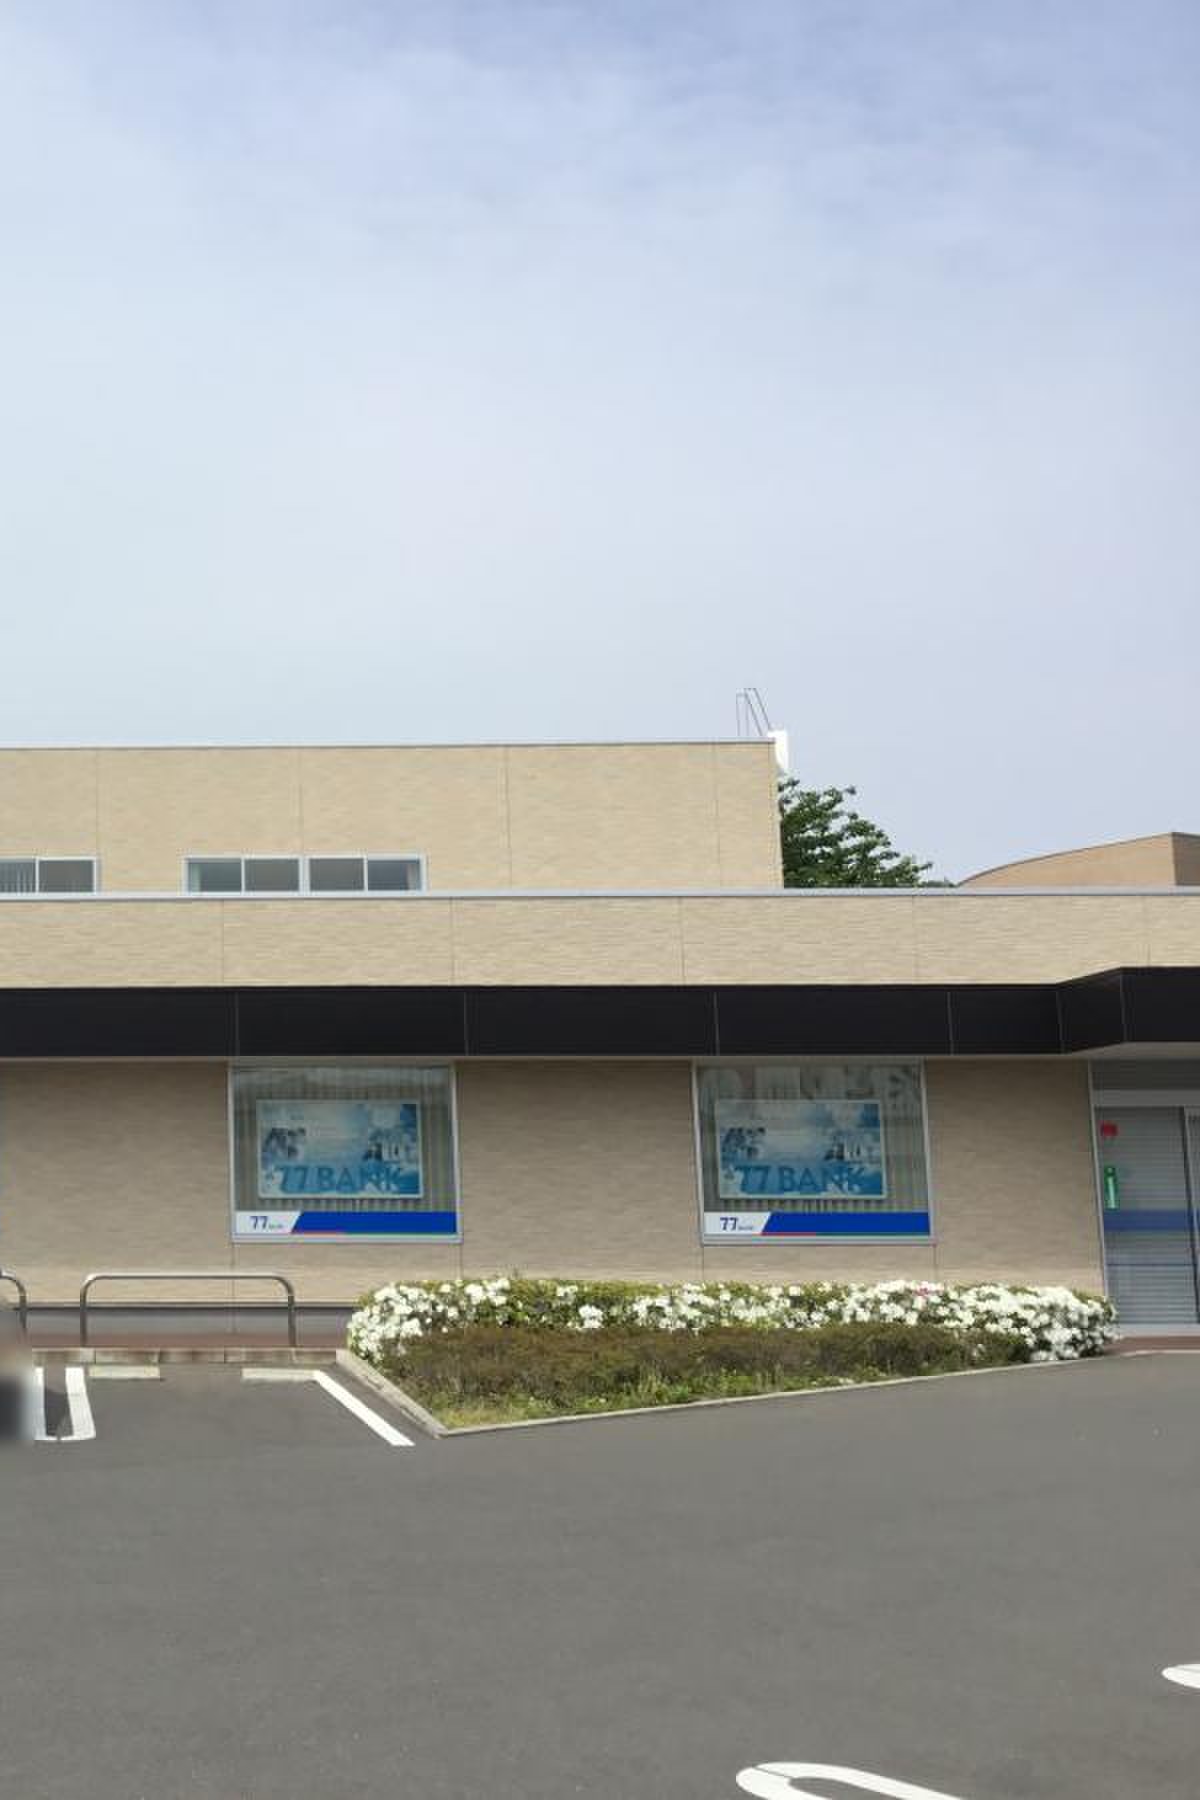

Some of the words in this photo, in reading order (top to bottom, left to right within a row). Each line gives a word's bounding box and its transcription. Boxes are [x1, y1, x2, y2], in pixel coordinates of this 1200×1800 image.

[273, 1166, 306, 1193] 77
[317, 1166, 402, 1193] BANK
[734, 1166, 770, 1192] 77
[778, 1166, 864, 1193] BANK
[250, 1215, 268, 1230] 77
[720, 1216, 738, 1231] 77
